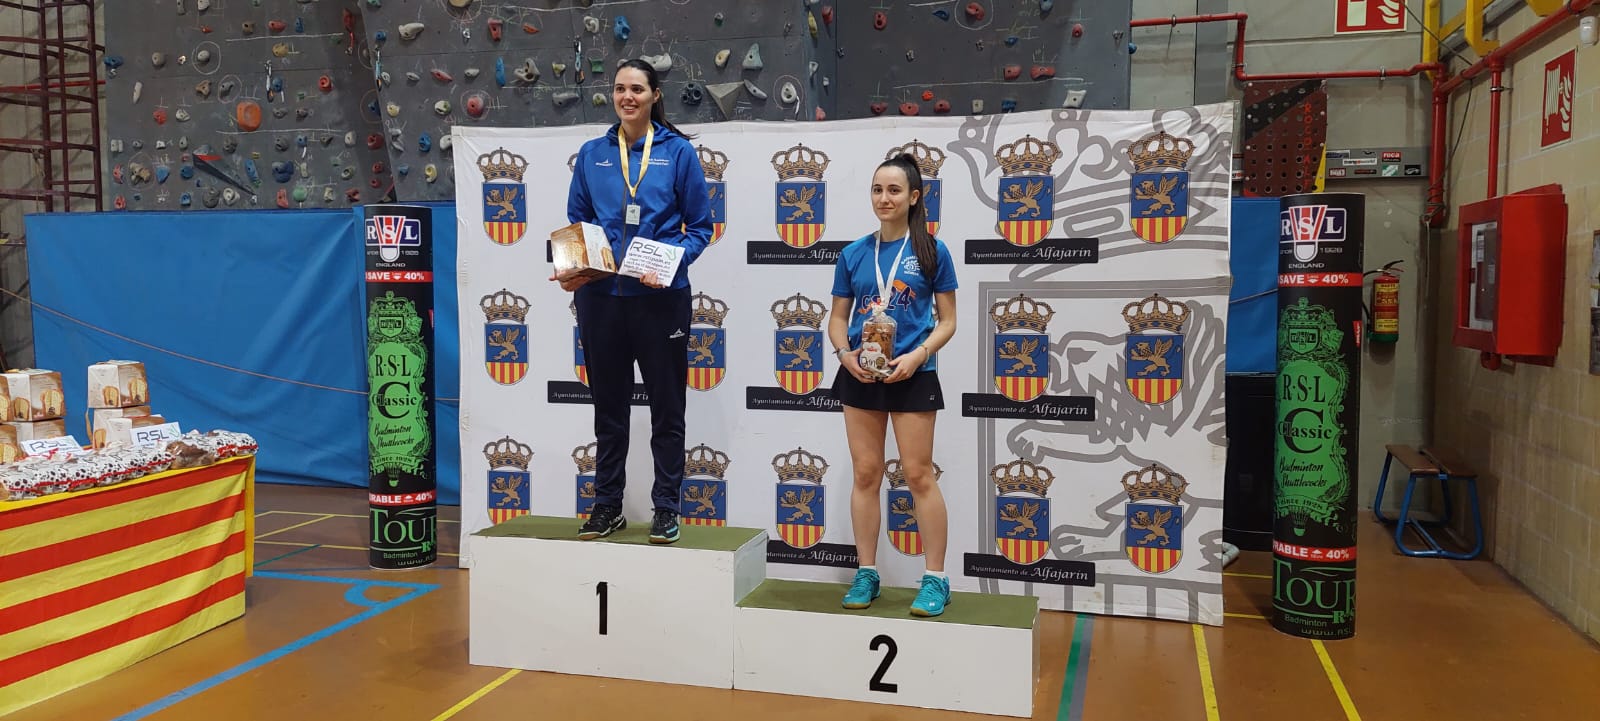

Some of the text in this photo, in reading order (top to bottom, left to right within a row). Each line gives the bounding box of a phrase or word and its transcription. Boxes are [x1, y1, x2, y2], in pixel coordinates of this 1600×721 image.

[1281, 215, 1343, 236] RSL
[367, 223, 418, 241] RSL
[629, 241, 663, 258] RSL
[971, 251, 1020, 260] Ayuntamiento
[752, 252, 797, 260] Ayuntamiento
[368, 272, 425, 280] SAVE 40%
[1280, 274, 1349, 285] SAVE 40%
[371, 394, 417, 406] Classic
[968, 404, 1017, 413] Ayuntamiento
[137, 429, 170, 443] RSL
[1278, 421, 1332, 439] Classic
[415, 492, 433, 501] 40%
[1326, 549, 1350, 559] 40%
[970, 564, 1018, 575] Ayuntamiento
[596, 581, 608, 635] 1
[1284, 614, 1328, 627] Badminton
[869, 634, 898, 693] 2
